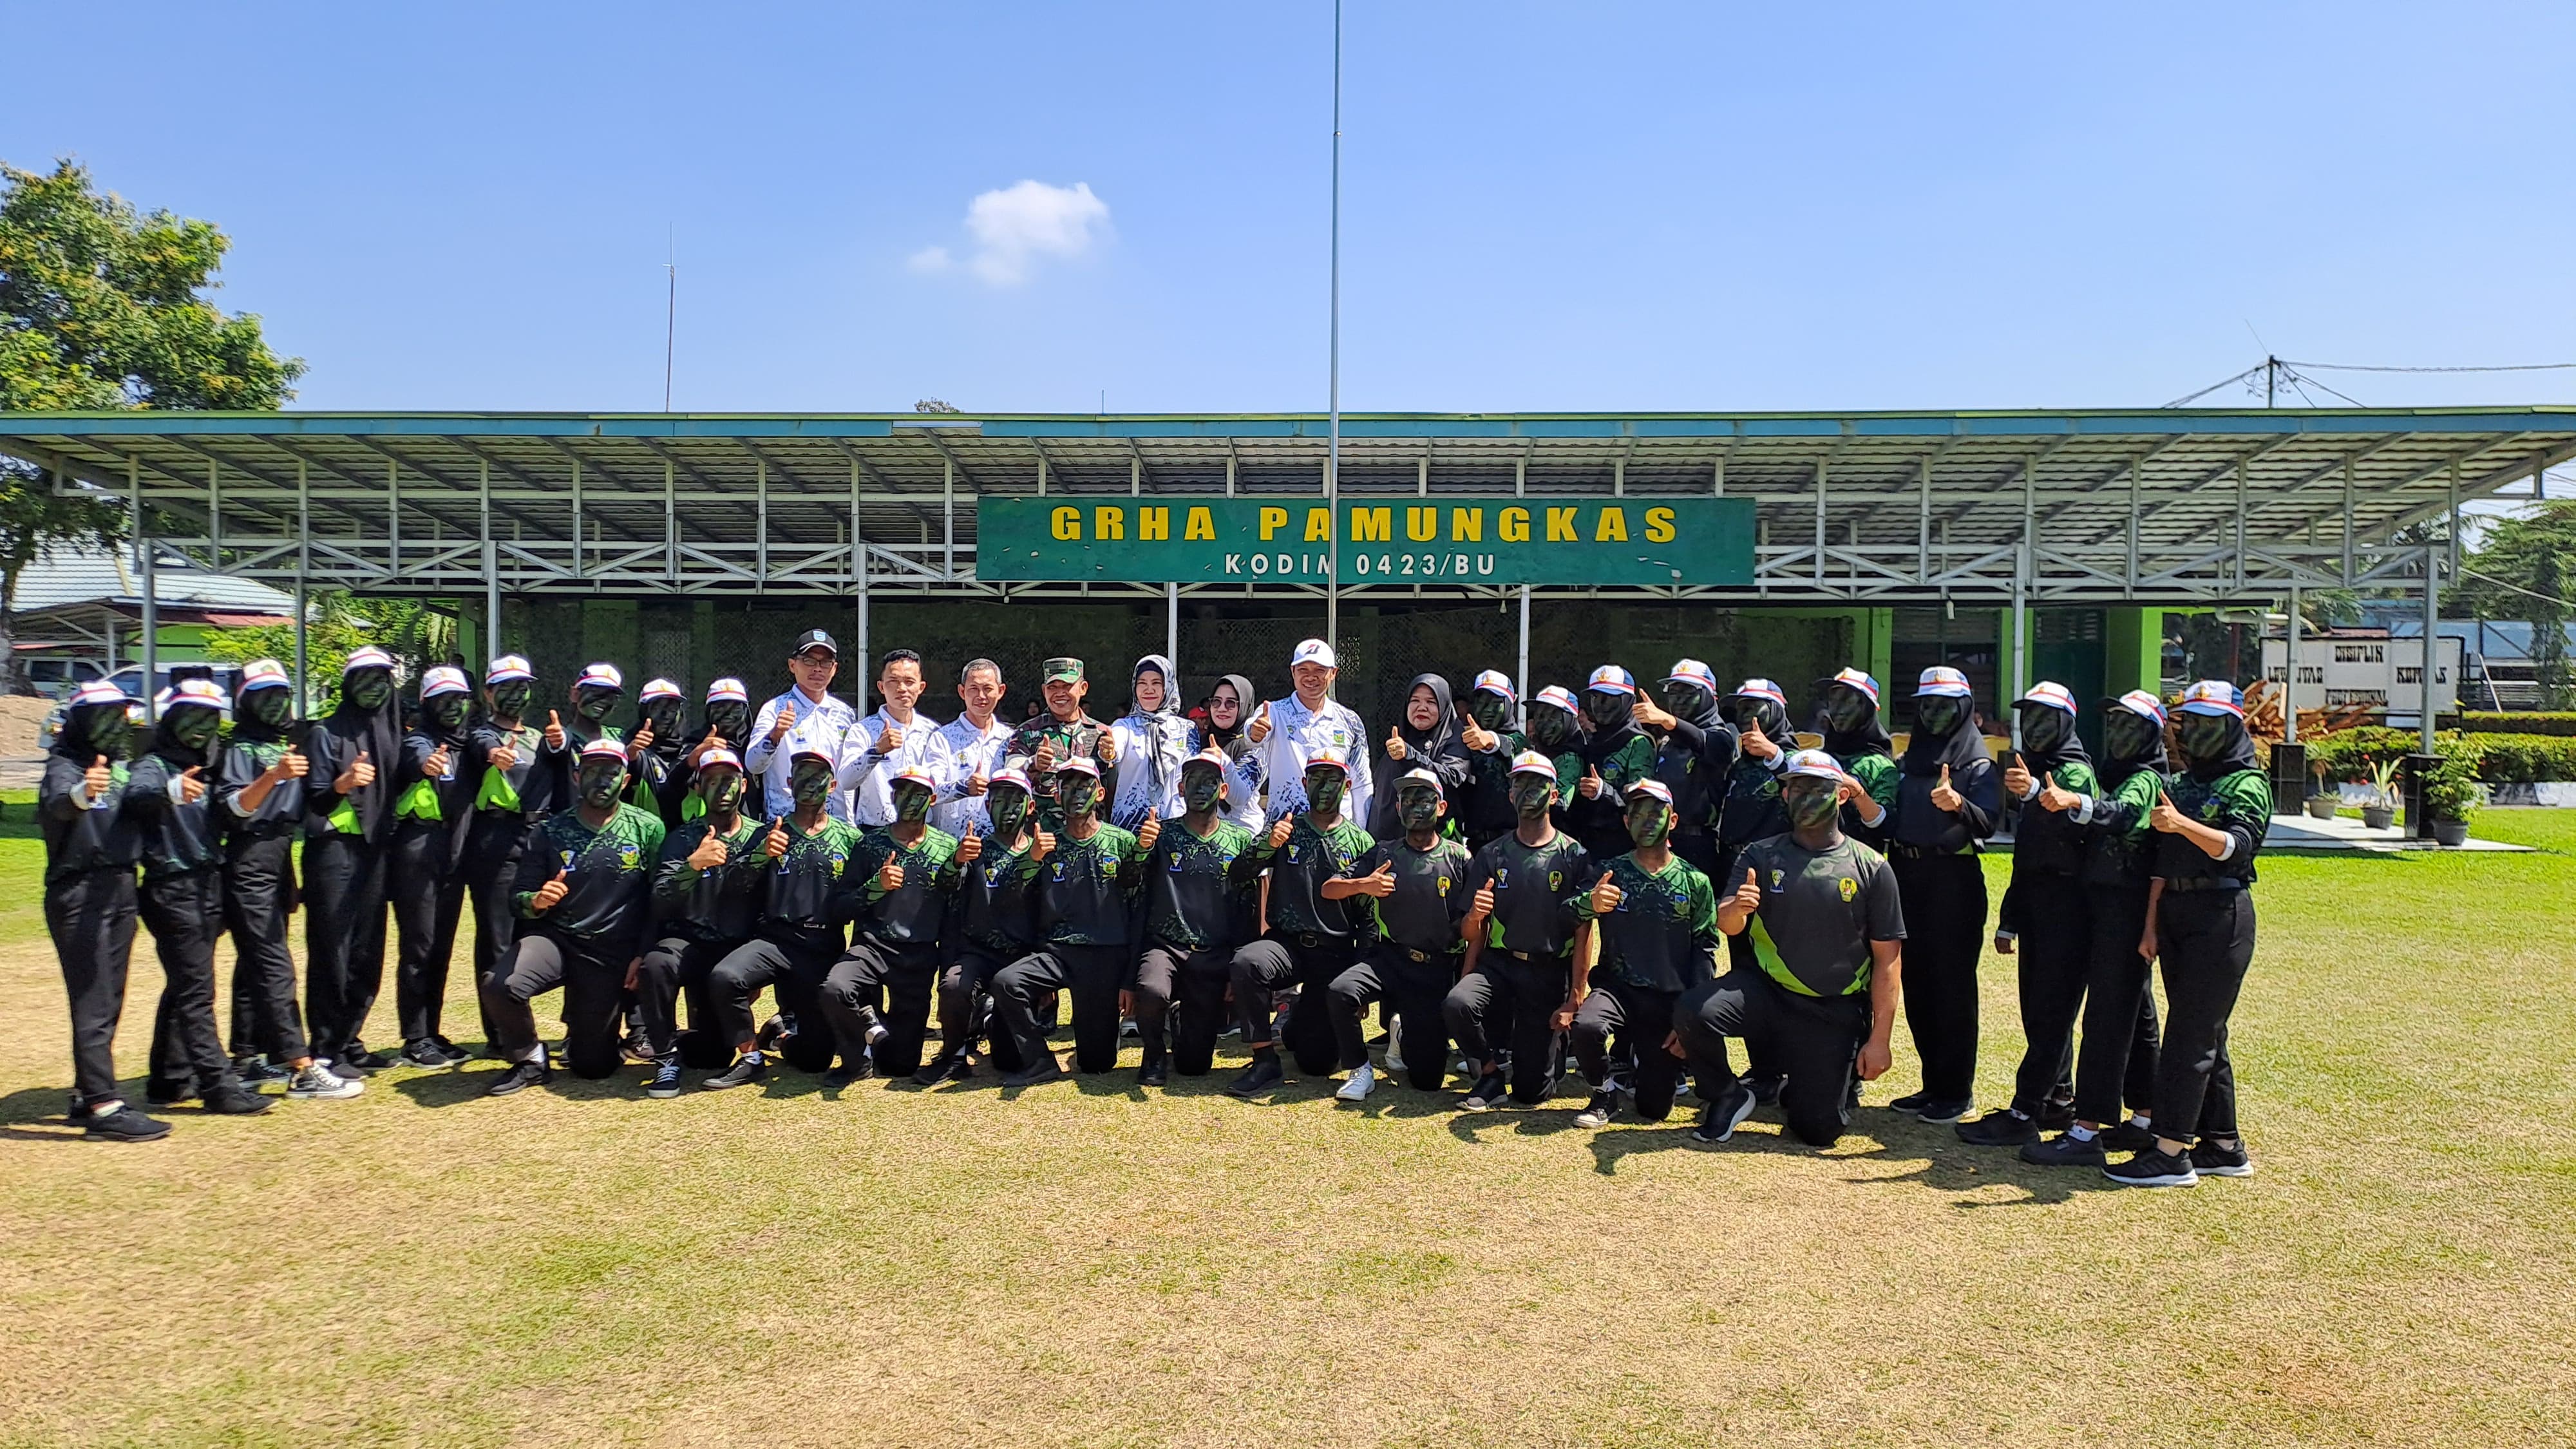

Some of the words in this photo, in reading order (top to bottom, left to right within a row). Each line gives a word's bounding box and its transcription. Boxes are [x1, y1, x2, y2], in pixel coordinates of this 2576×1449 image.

[1051, 506, 1217, 540] GRHA
[1259, 506, 1676, 543] PAMUNGKAS
[1356, 553, 1495, 576] 0423/BU
